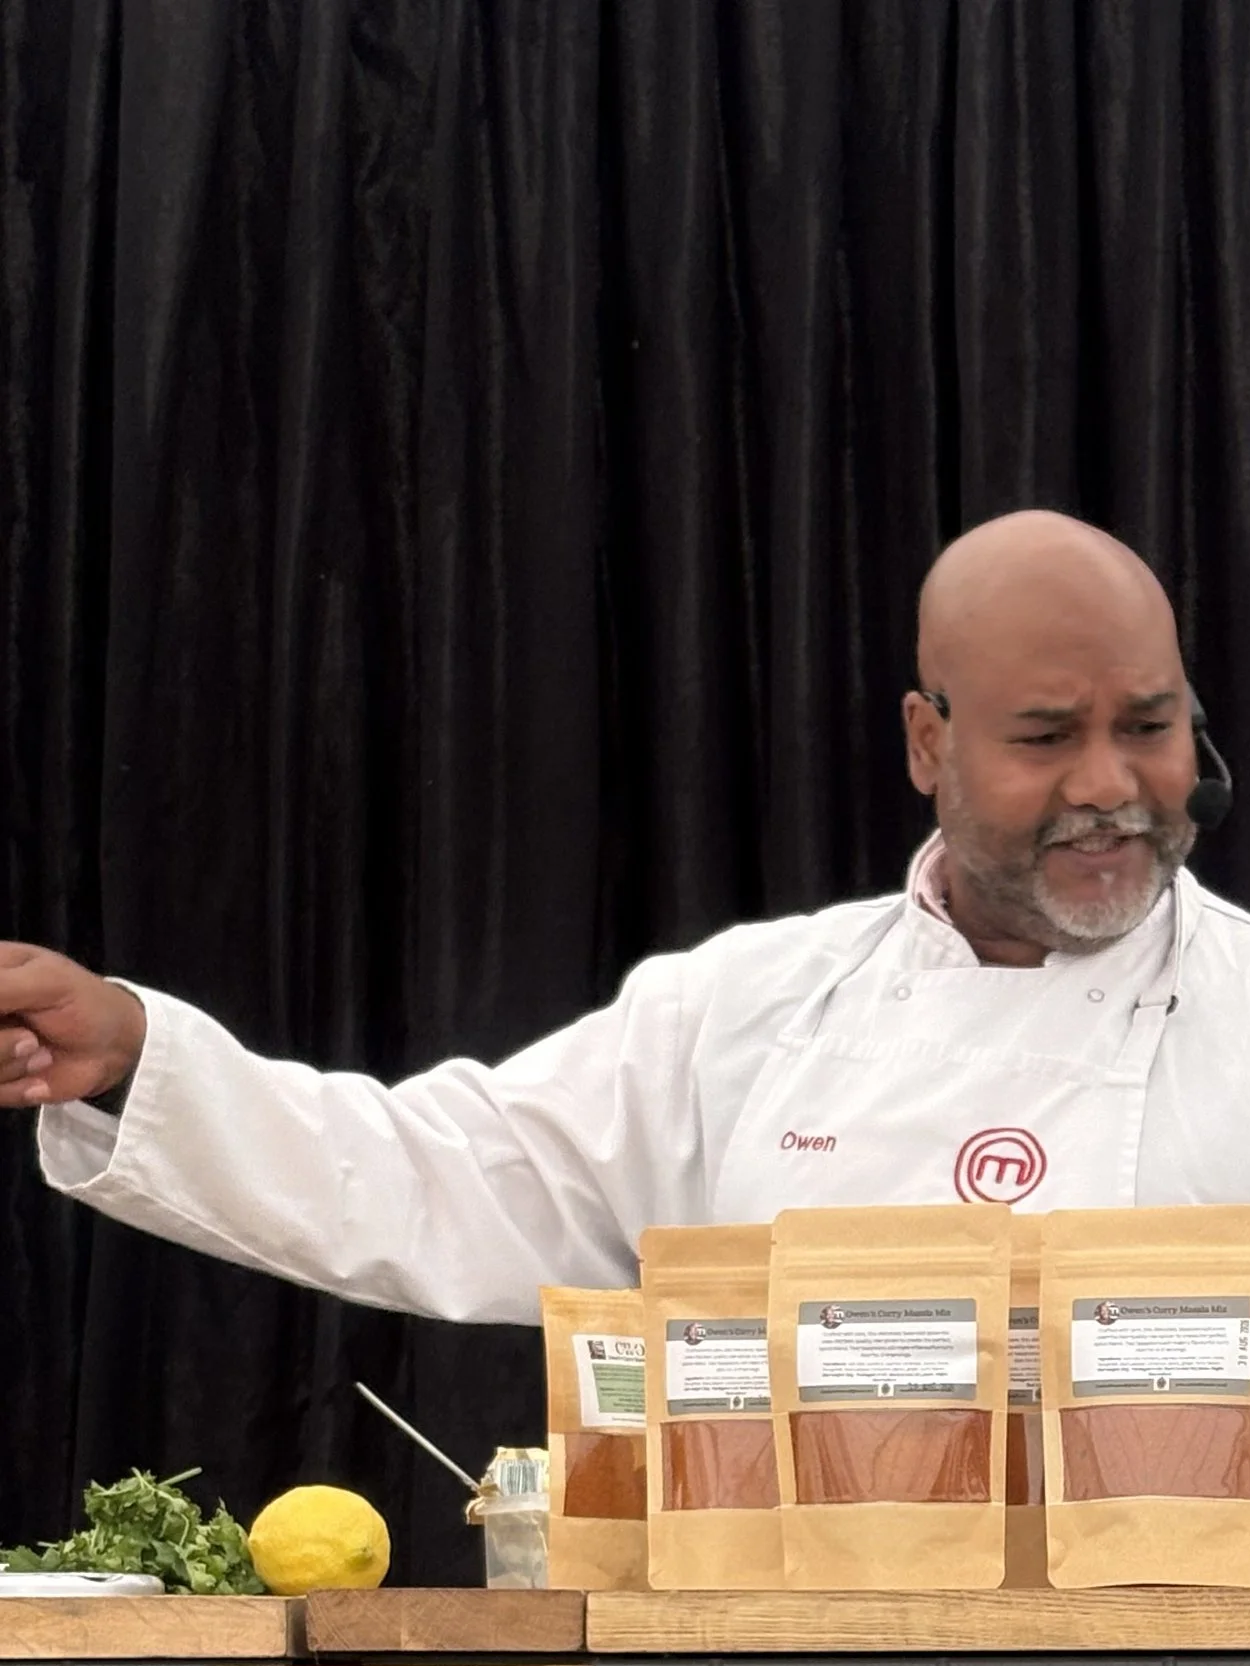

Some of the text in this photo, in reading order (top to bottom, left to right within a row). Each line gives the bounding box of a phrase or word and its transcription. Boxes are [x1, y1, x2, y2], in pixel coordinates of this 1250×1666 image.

[781, 1131, 837, 1152] Owen
[877, 1309, 902, 1319] Curry
[1152, 1305, 1177, 1315] Curry
